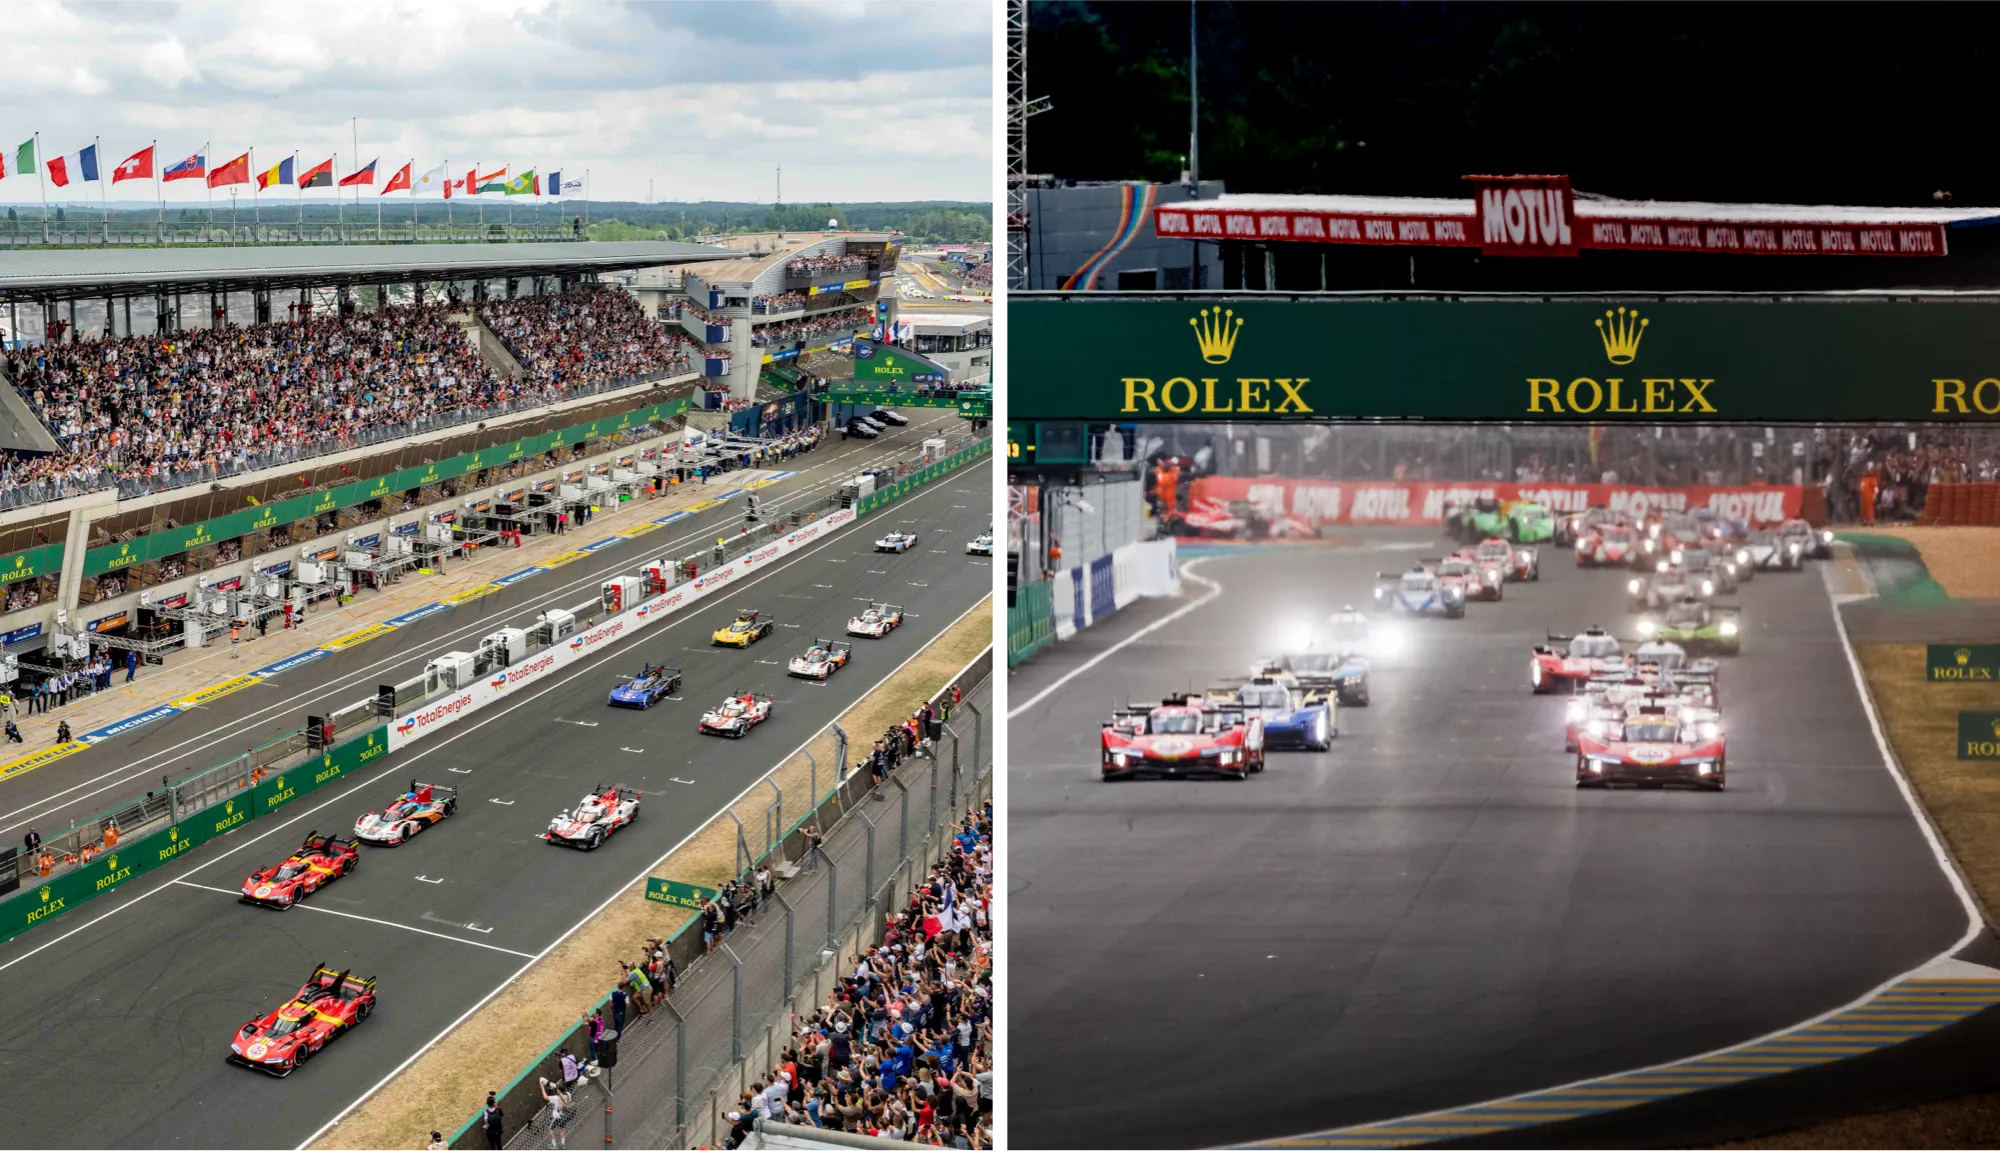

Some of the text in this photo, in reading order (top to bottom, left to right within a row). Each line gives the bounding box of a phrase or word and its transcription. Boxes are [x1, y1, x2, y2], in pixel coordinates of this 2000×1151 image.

[1159, 212, 1466, 242] MOTUL MOTUL MOTUL MOTUL MOTUL MOTUL MOTUL MOTUL MOTUL
[1483, 188, 1572, 246] MOTUL
[1593, 223, 1934, 252] MOTUL MOTUL MOTUL MOTUL MOTUL MOTUL MOTUL MOTUL MOTUL
[874, 366, 904, 374] ROLEX
[1120, 377, 1314, 414] ROLEX
[1526, 377, 1718, 414] ROLEX
[370, 487, 390, 497] ROLEX
[315, 501, 337, 512] ROLEX
[1351, 488, 1411, 519] MOTUL
[1708, 491, 1785, 522] MOTUL
[253, 516, 277, 529] ROLEX
[185, 534, 212, 548] ROLEX
[108, 554, 137, 569] ROLEX
[752, 544, 779, 563] TotalEnergies
[1, 566, 34, 582] ROLEX
[703, 567, 734, 588] TotalEnergies
[648, 591, 683, 614] TotalEnergies
[583, 620, 624, 647] TotalEnergies
[273, 650, 325, 671] MICHELIN
[507, 654, 555, 684] TotalEnergies
[1933, 667, 1992, 679] ROLEX
[195, 677, 253, 701] MICHELIN
[106, 707, 173, 735] MICHELIN
[416, 693, 472, 728] TotalEnergies
[4, 743, 79, 775] MICHELIN
[315, 764, 341, 783] ROLEX
[267, 786, 296, 807] ROLEX
[215, 811, 245, 833] ROLEX
[96, 866, 131, 891] ROLEX
[648, 891, 678, 904] ROLEX
